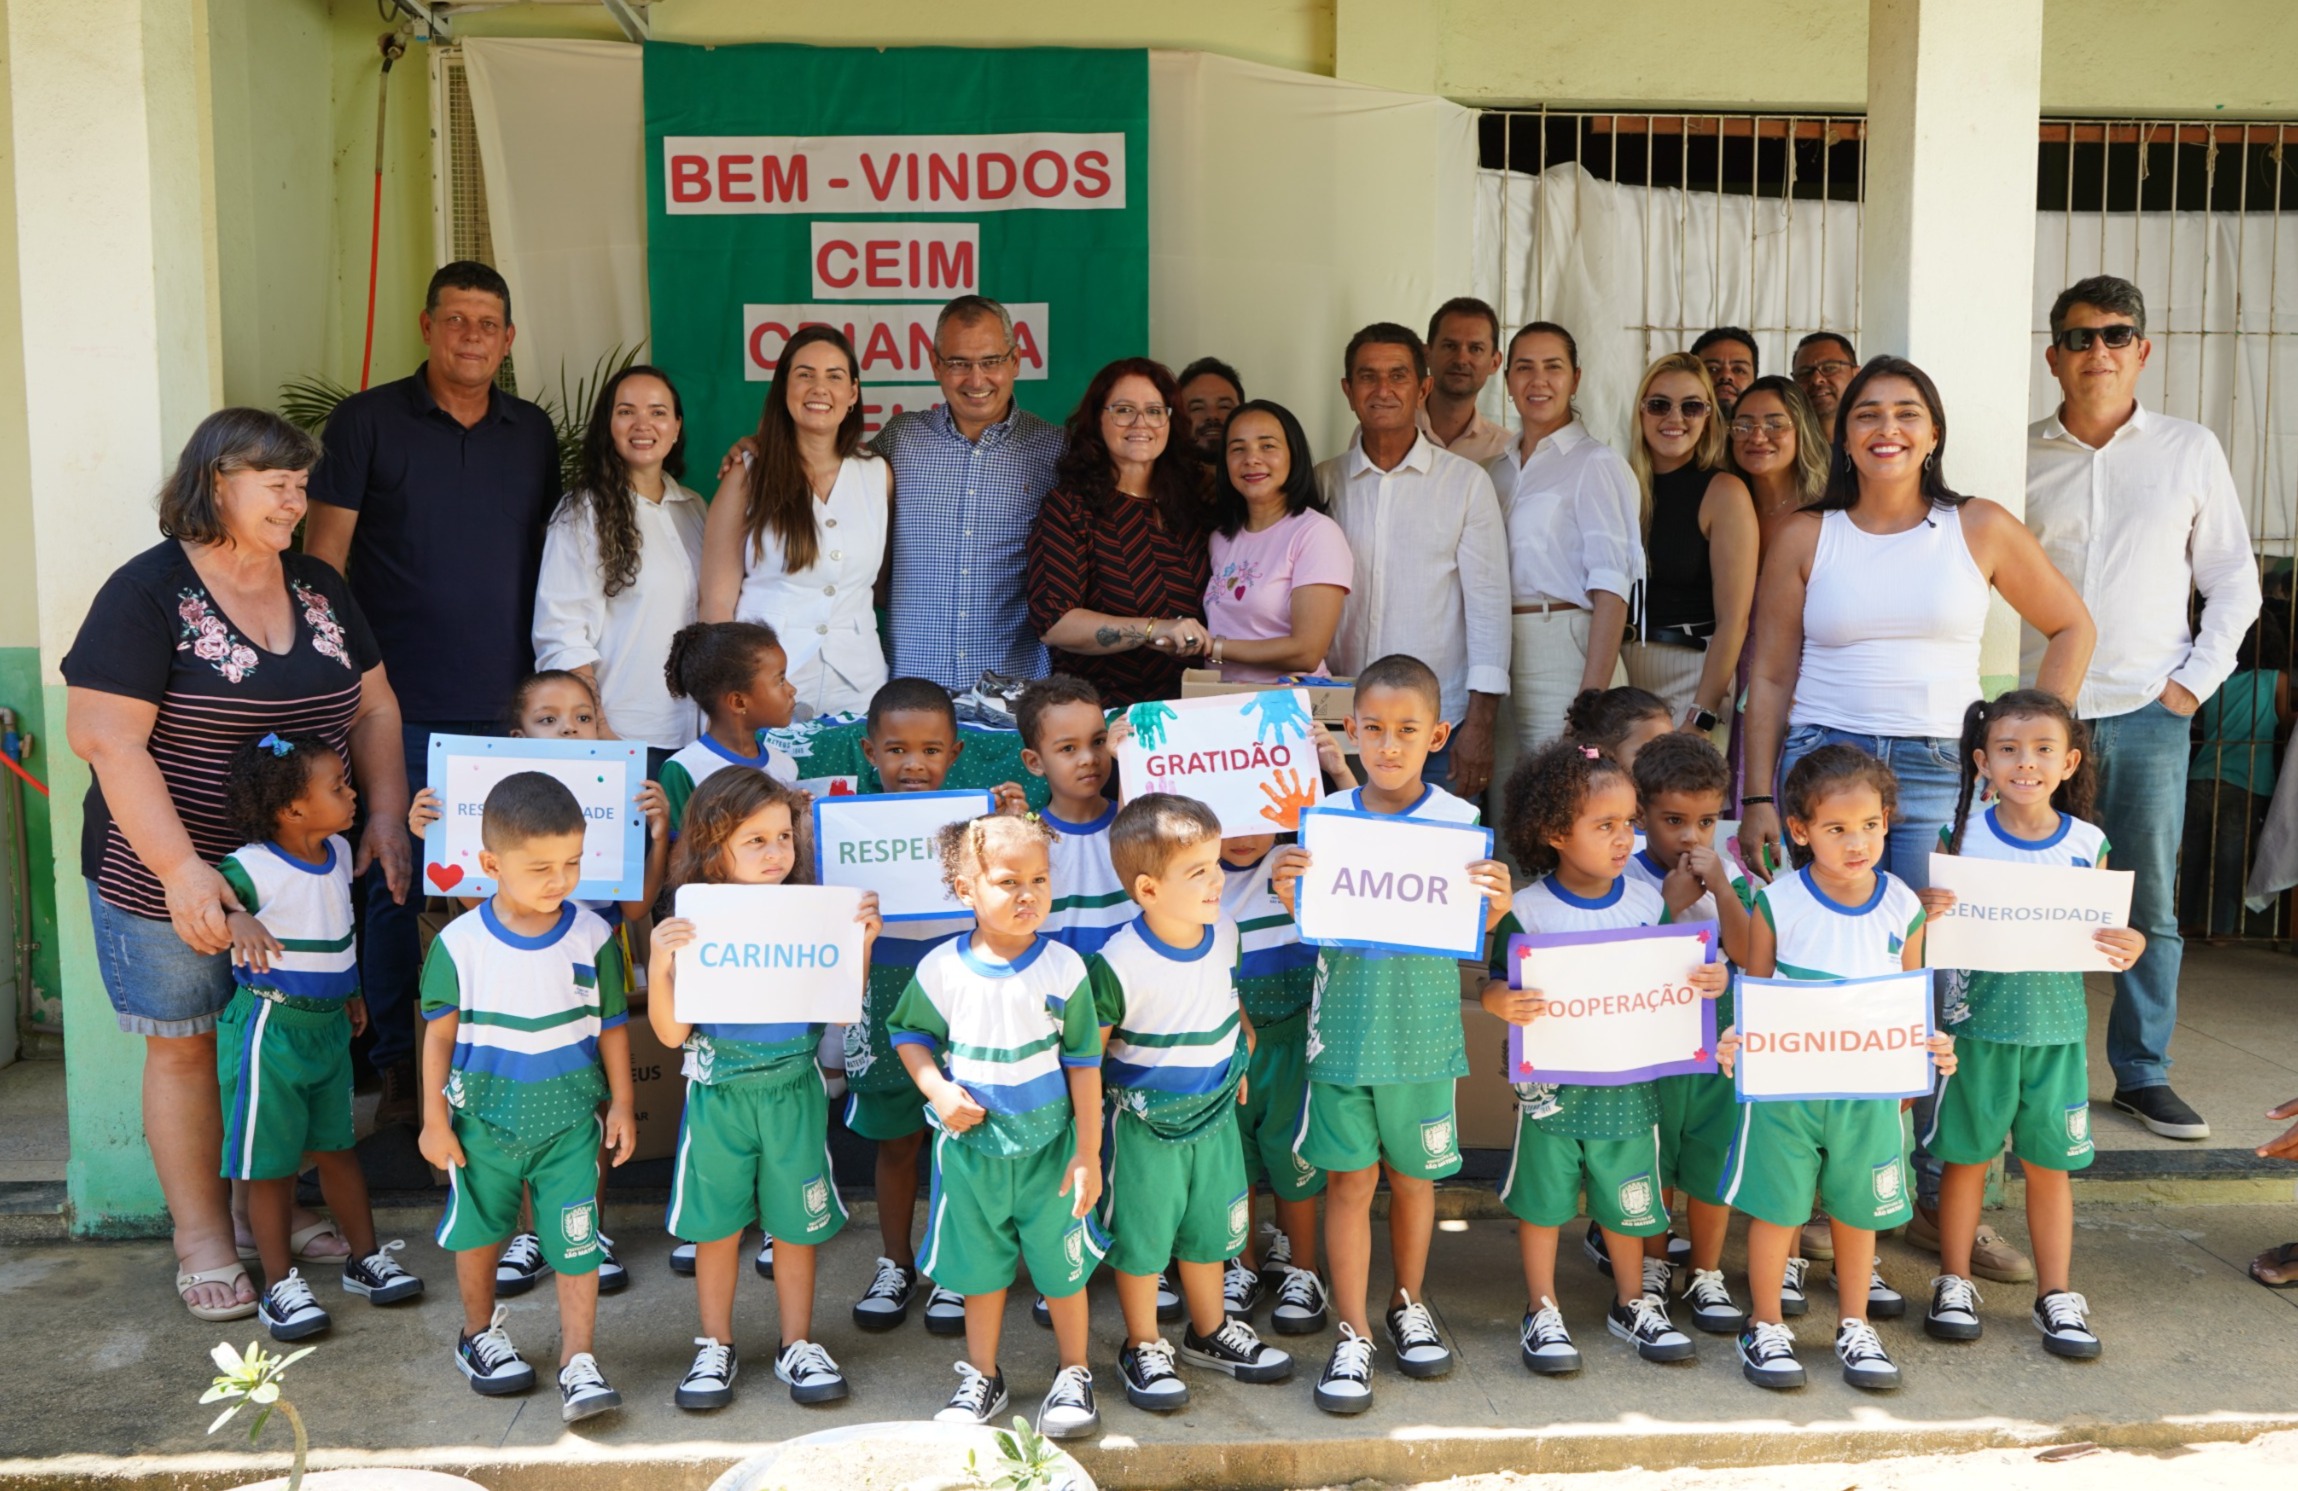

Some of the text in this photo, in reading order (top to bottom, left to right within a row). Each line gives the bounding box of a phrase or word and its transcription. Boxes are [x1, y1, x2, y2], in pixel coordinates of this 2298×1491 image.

[670, 154, 809, 204] BEM
[815, 239, 974, 289] CEIM
[1145, 741, 1291, 777] GRATIDÃO
[838, 836, 935, 865] RESPEI
[1330, 867, 1449, 906] AMOR
[698, 941, 840, 979] CARINHO
[1547, 983, 1695, 1019] OOPERAÇÃO
[1744, 1023, 1926, 1054] DIGNIDADE
